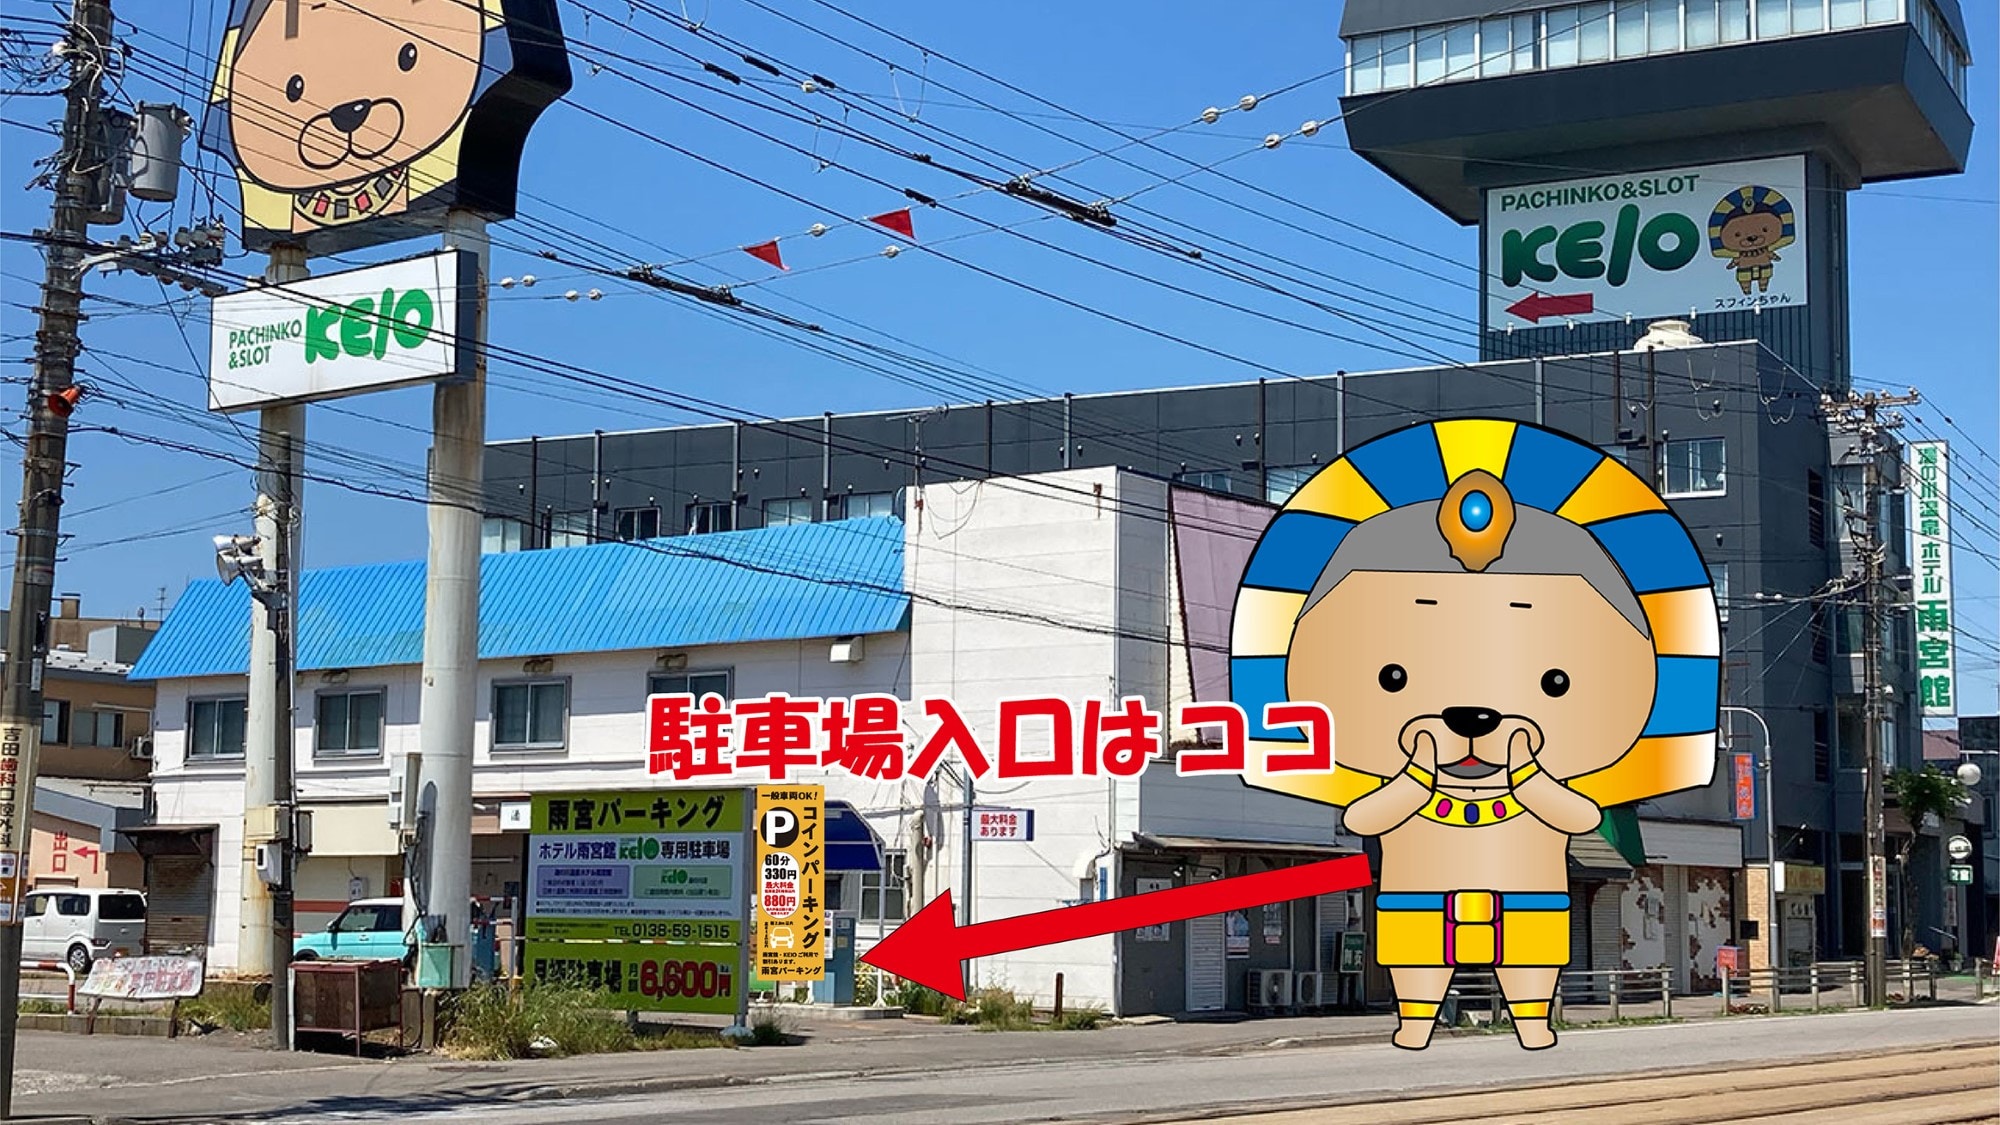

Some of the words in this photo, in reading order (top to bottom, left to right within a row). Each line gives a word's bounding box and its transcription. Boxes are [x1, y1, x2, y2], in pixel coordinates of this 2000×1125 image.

[1501, 174, 1700, 212] PACHINKO&SLOT
[1715, 293, 1791, 309] スフィンちゃん
[229, 319, 301, 349] PACHINKO
[228, 345, 272, 369] &SLOT
[548, 795, 725, 831] 雨宮パーキング
[980, 814, 1017, 825] 最大料金
[766, 810, 795, 845] P
[980, 827, 1017, 837] あります
[52, 830, 68, 873] 出口
[765, 854, 790, 866] 60分
[765, 868, 797, 880] 330円
[801, 806, 820, 949] コインパーキング
[764, 895, 796, 907] 880円
[761, 966, 822, 976] 雨宮パーキング
